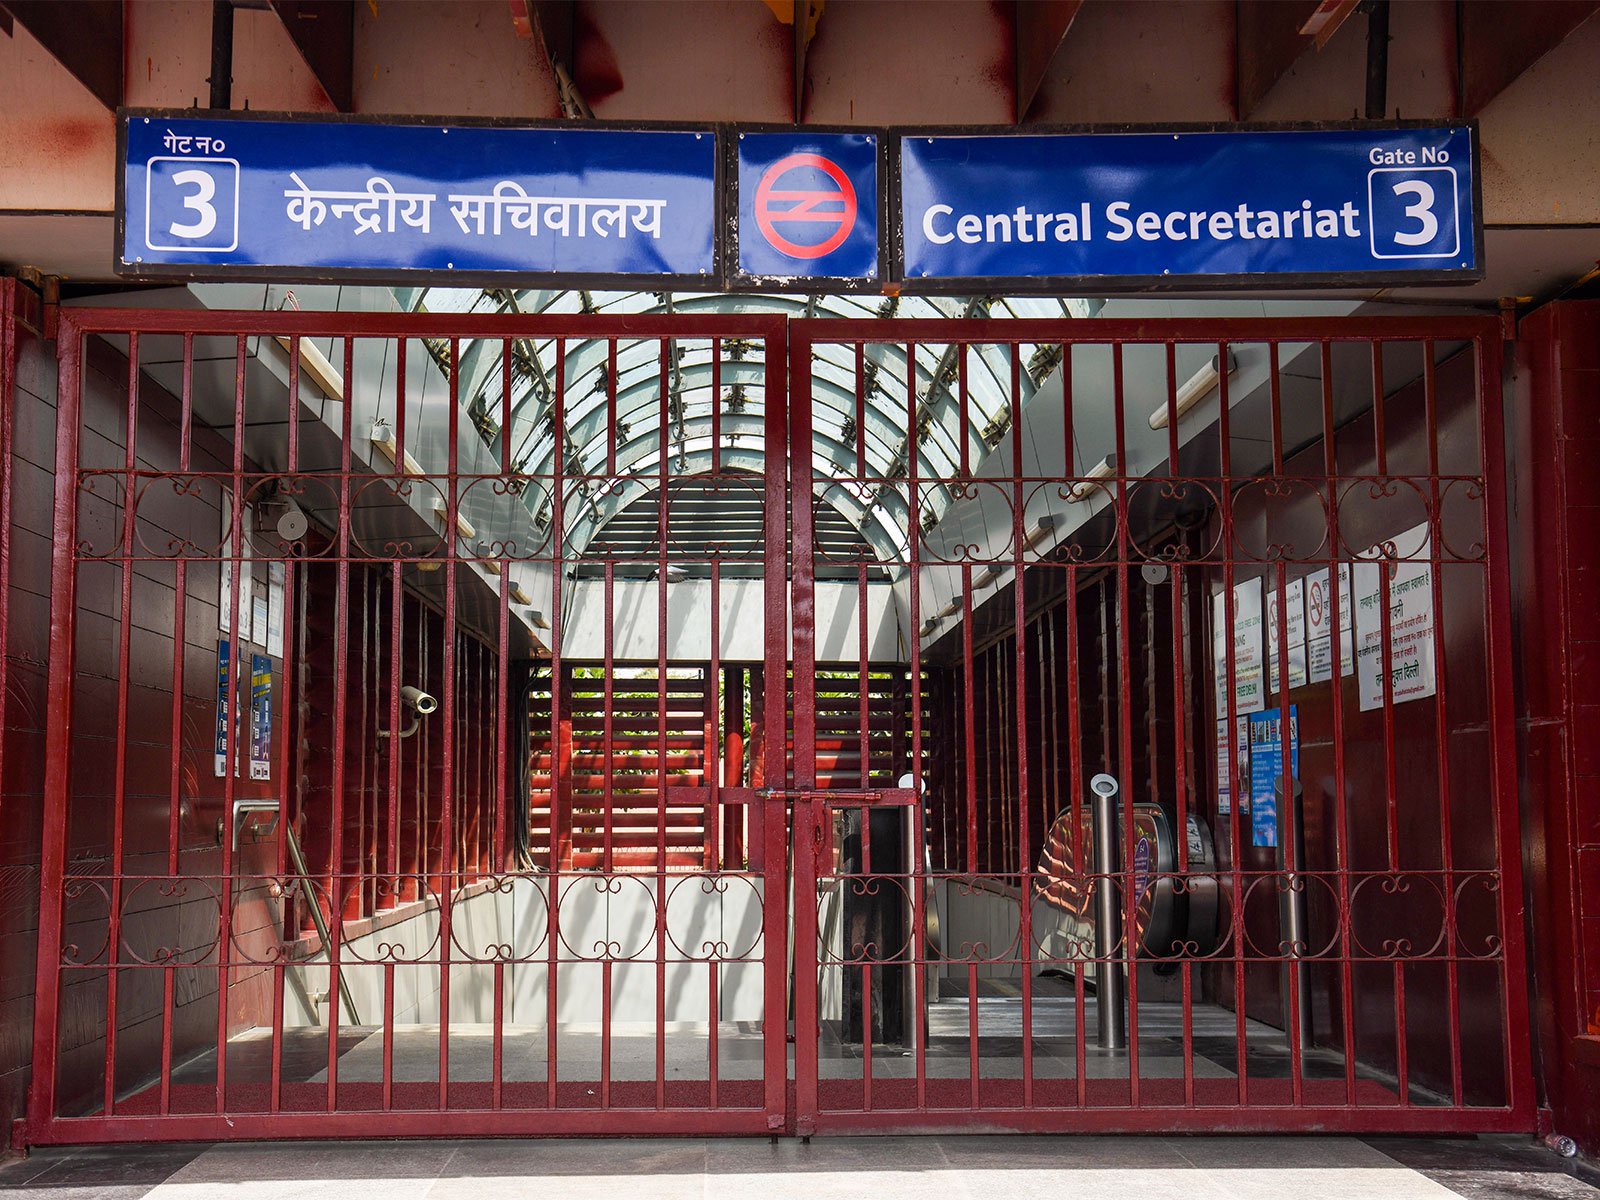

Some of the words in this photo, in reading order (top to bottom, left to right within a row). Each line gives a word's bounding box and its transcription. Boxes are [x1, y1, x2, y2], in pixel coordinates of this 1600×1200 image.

[163, 129, 192, 154] गेट
[1369, 147, 1416, 166] Gate
[1421, 146, 1450, 164] No
[169, 169, 217, 239] 3
[284, 171, 437, 236] केन्द्रीय
[448, 180, 667, 239] सचिवालय
[922, 202, 1092, 245] Central
[1105, 199, 1361, 242] Secretariat
[1391, 179, 1439, 246] 3
